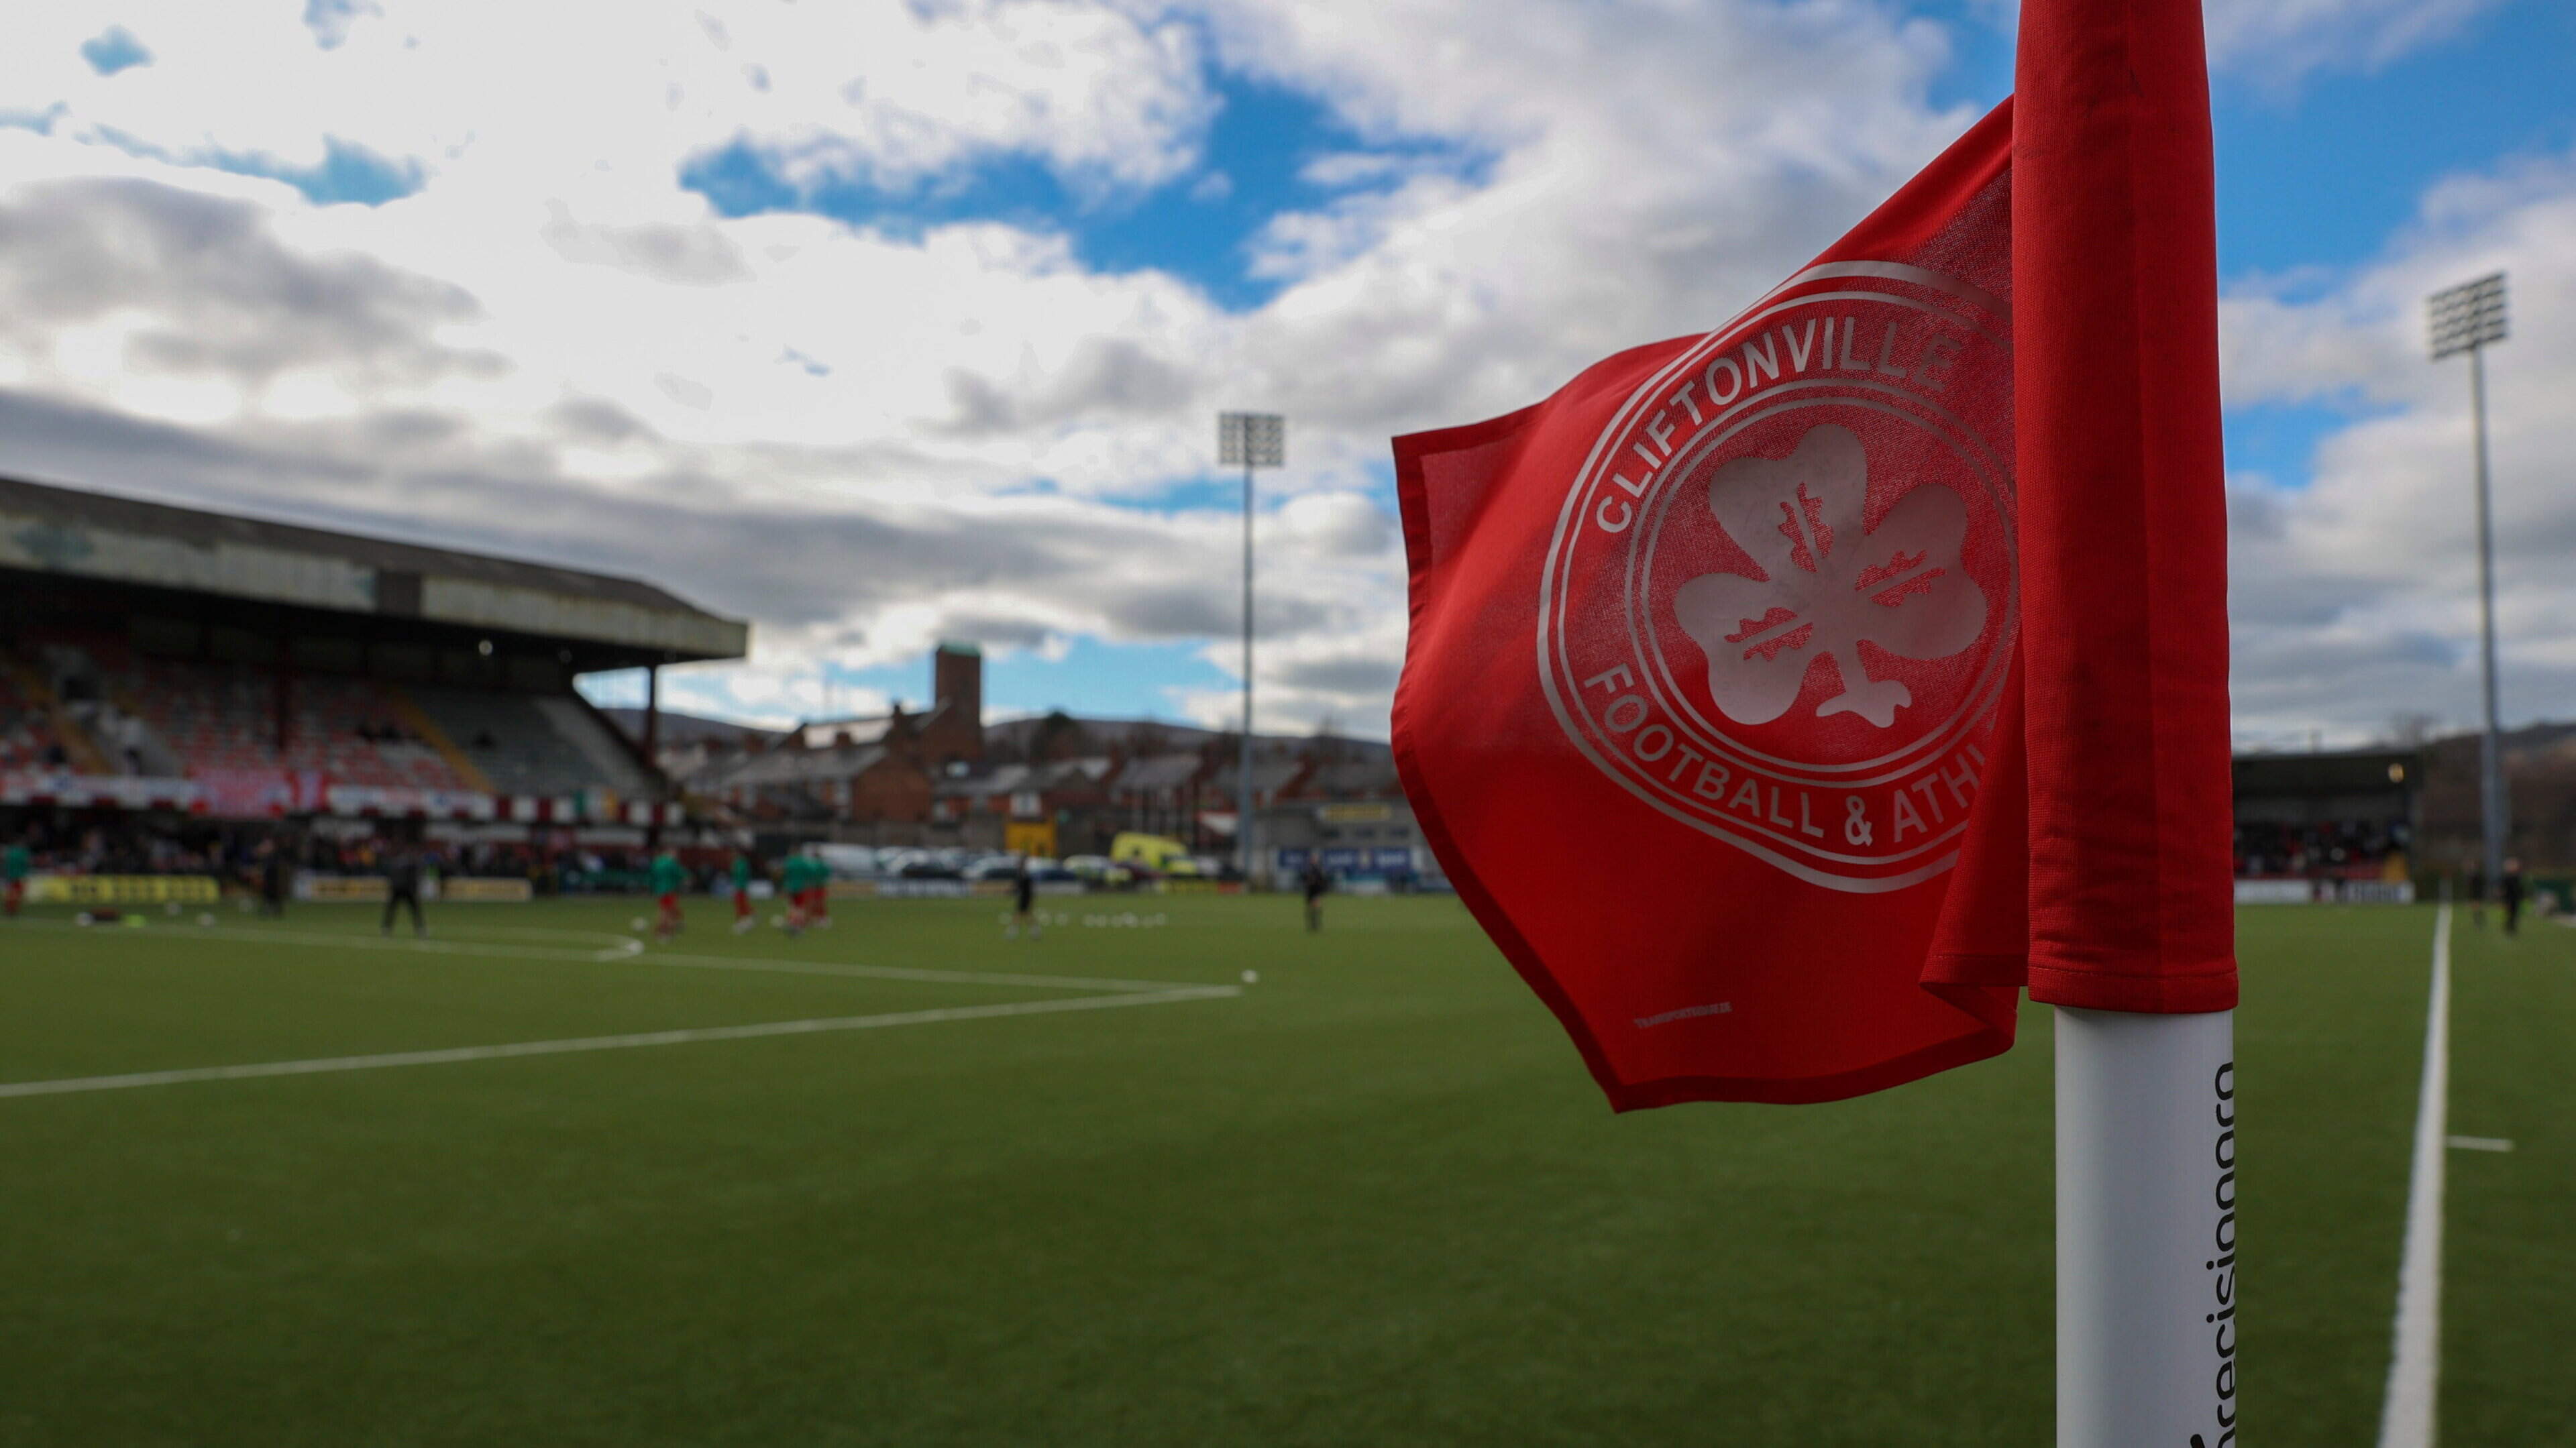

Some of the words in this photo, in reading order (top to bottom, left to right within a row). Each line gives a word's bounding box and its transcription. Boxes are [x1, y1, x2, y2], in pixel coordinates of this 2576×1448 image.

[1596, 316, 1963, 534] CLIFTONVILLE
[1584, 663, 1825, 838] FOOTBALL
[1844, 795, 1873, 847] &
